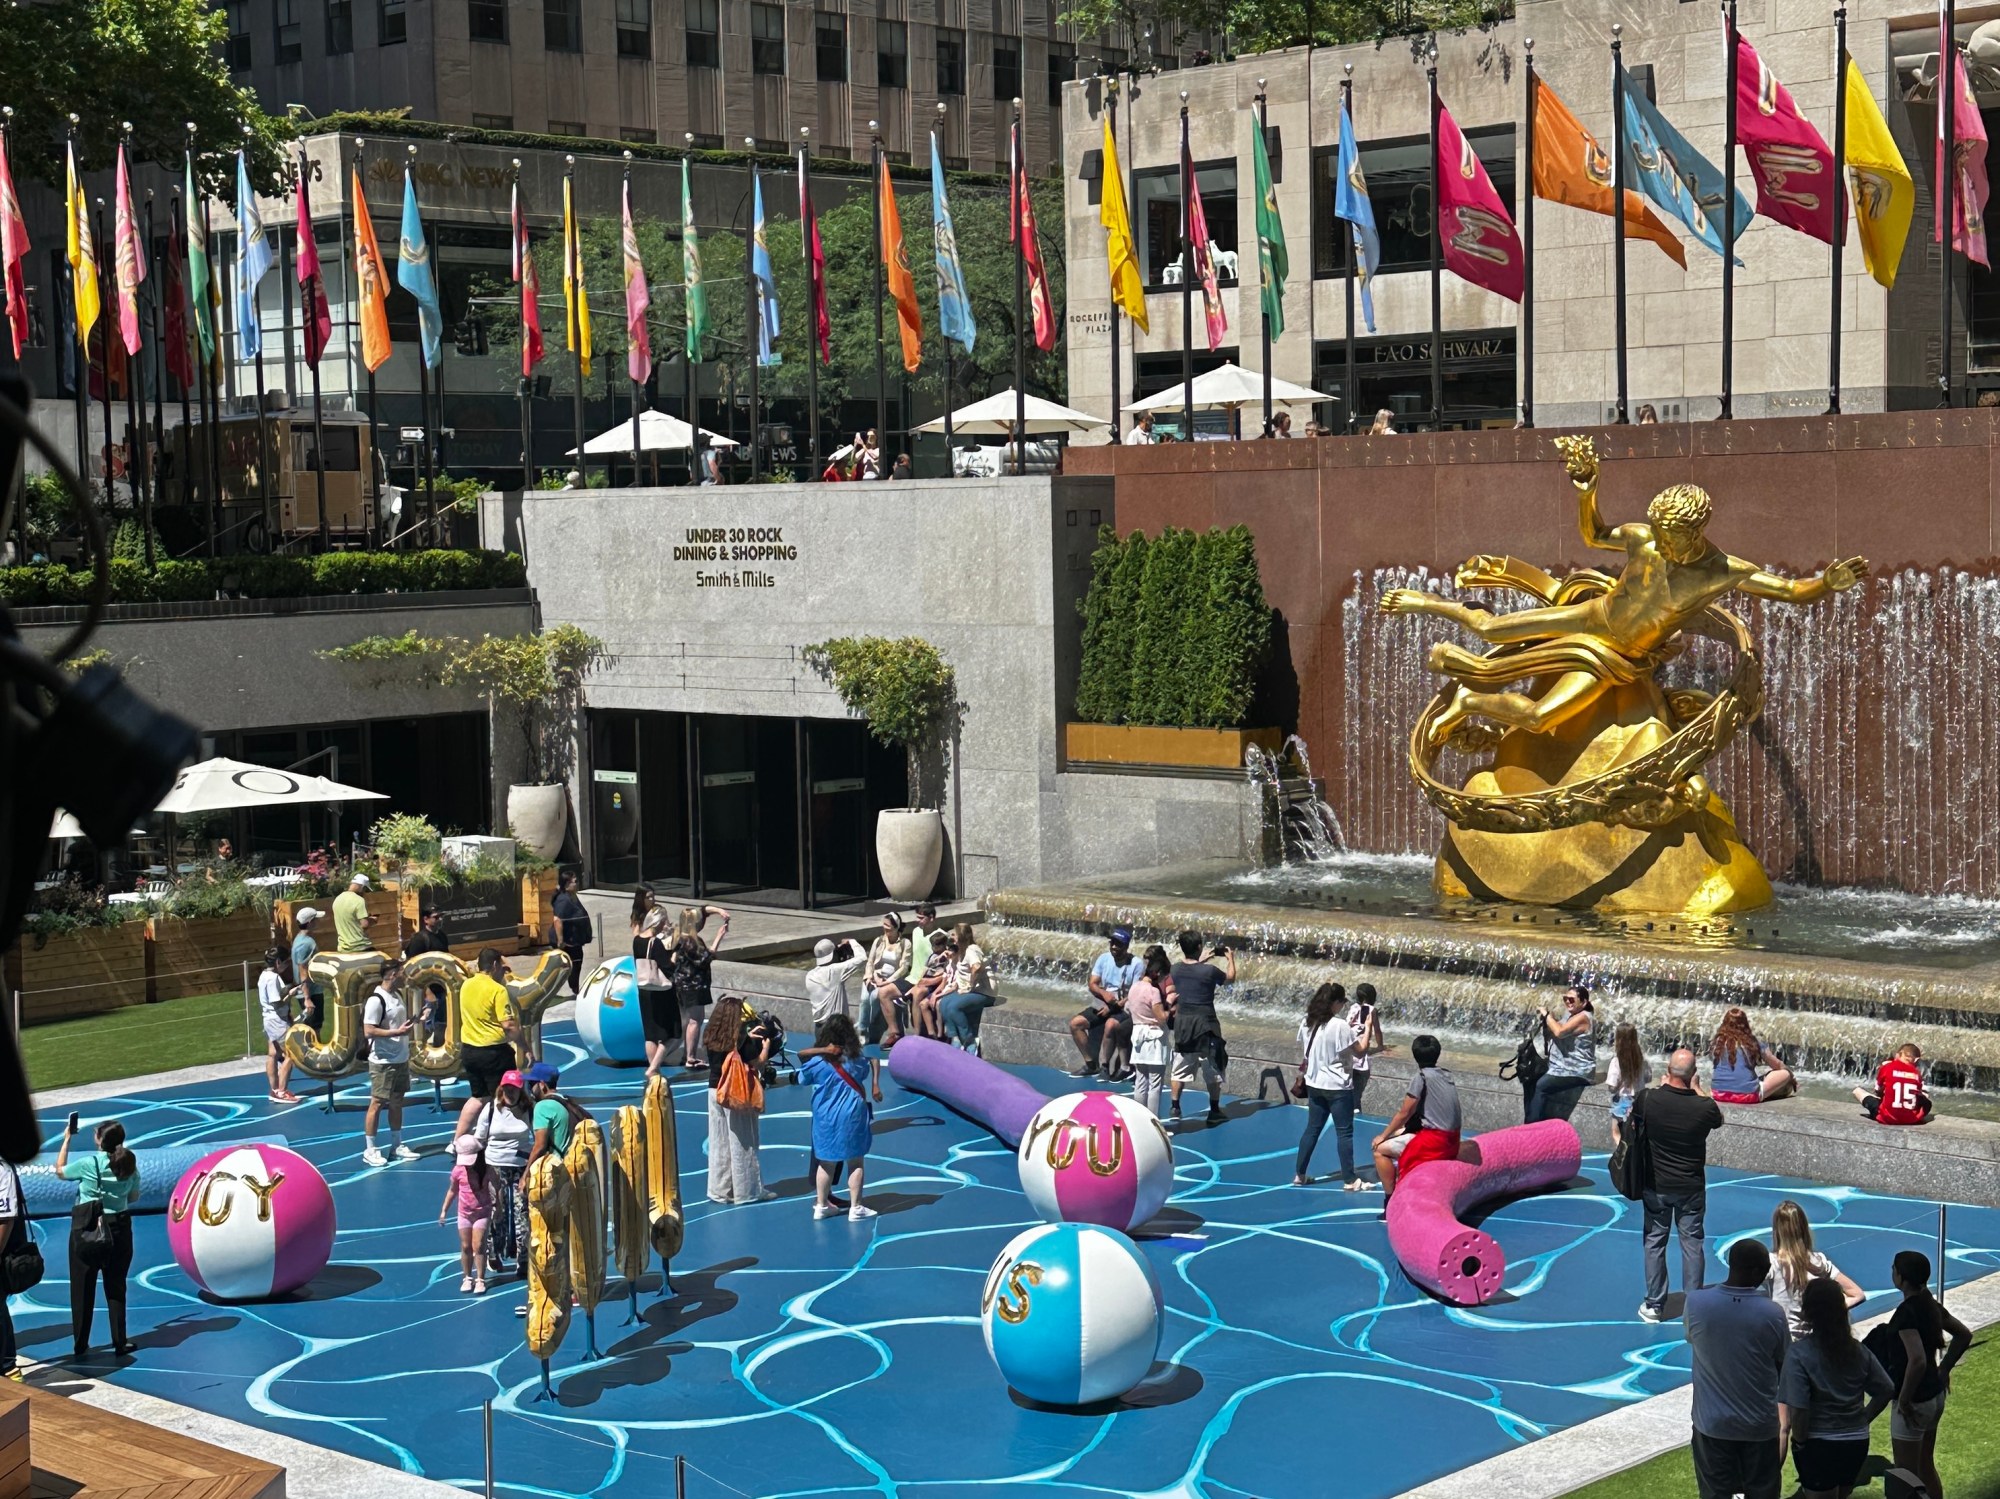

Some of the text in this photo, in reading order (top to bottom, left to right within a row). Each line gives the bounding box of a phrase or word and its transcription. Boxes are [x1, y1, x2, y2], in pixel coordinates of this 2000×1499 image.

[686, 528, 782, 543] UNDER 30 ROCK
[674, 546, 797, 560] DINING & SHOPPING
[697, 571, 731, 587] Smith
[743, 571, 774, 587] Mills
[1892, 1081, 1918, 1110] 15
[1024, 1113, 1124, 1176] YOU
[172, 1171, 285, 1226] JOY
[982, 1252, 1045, 1324] US
